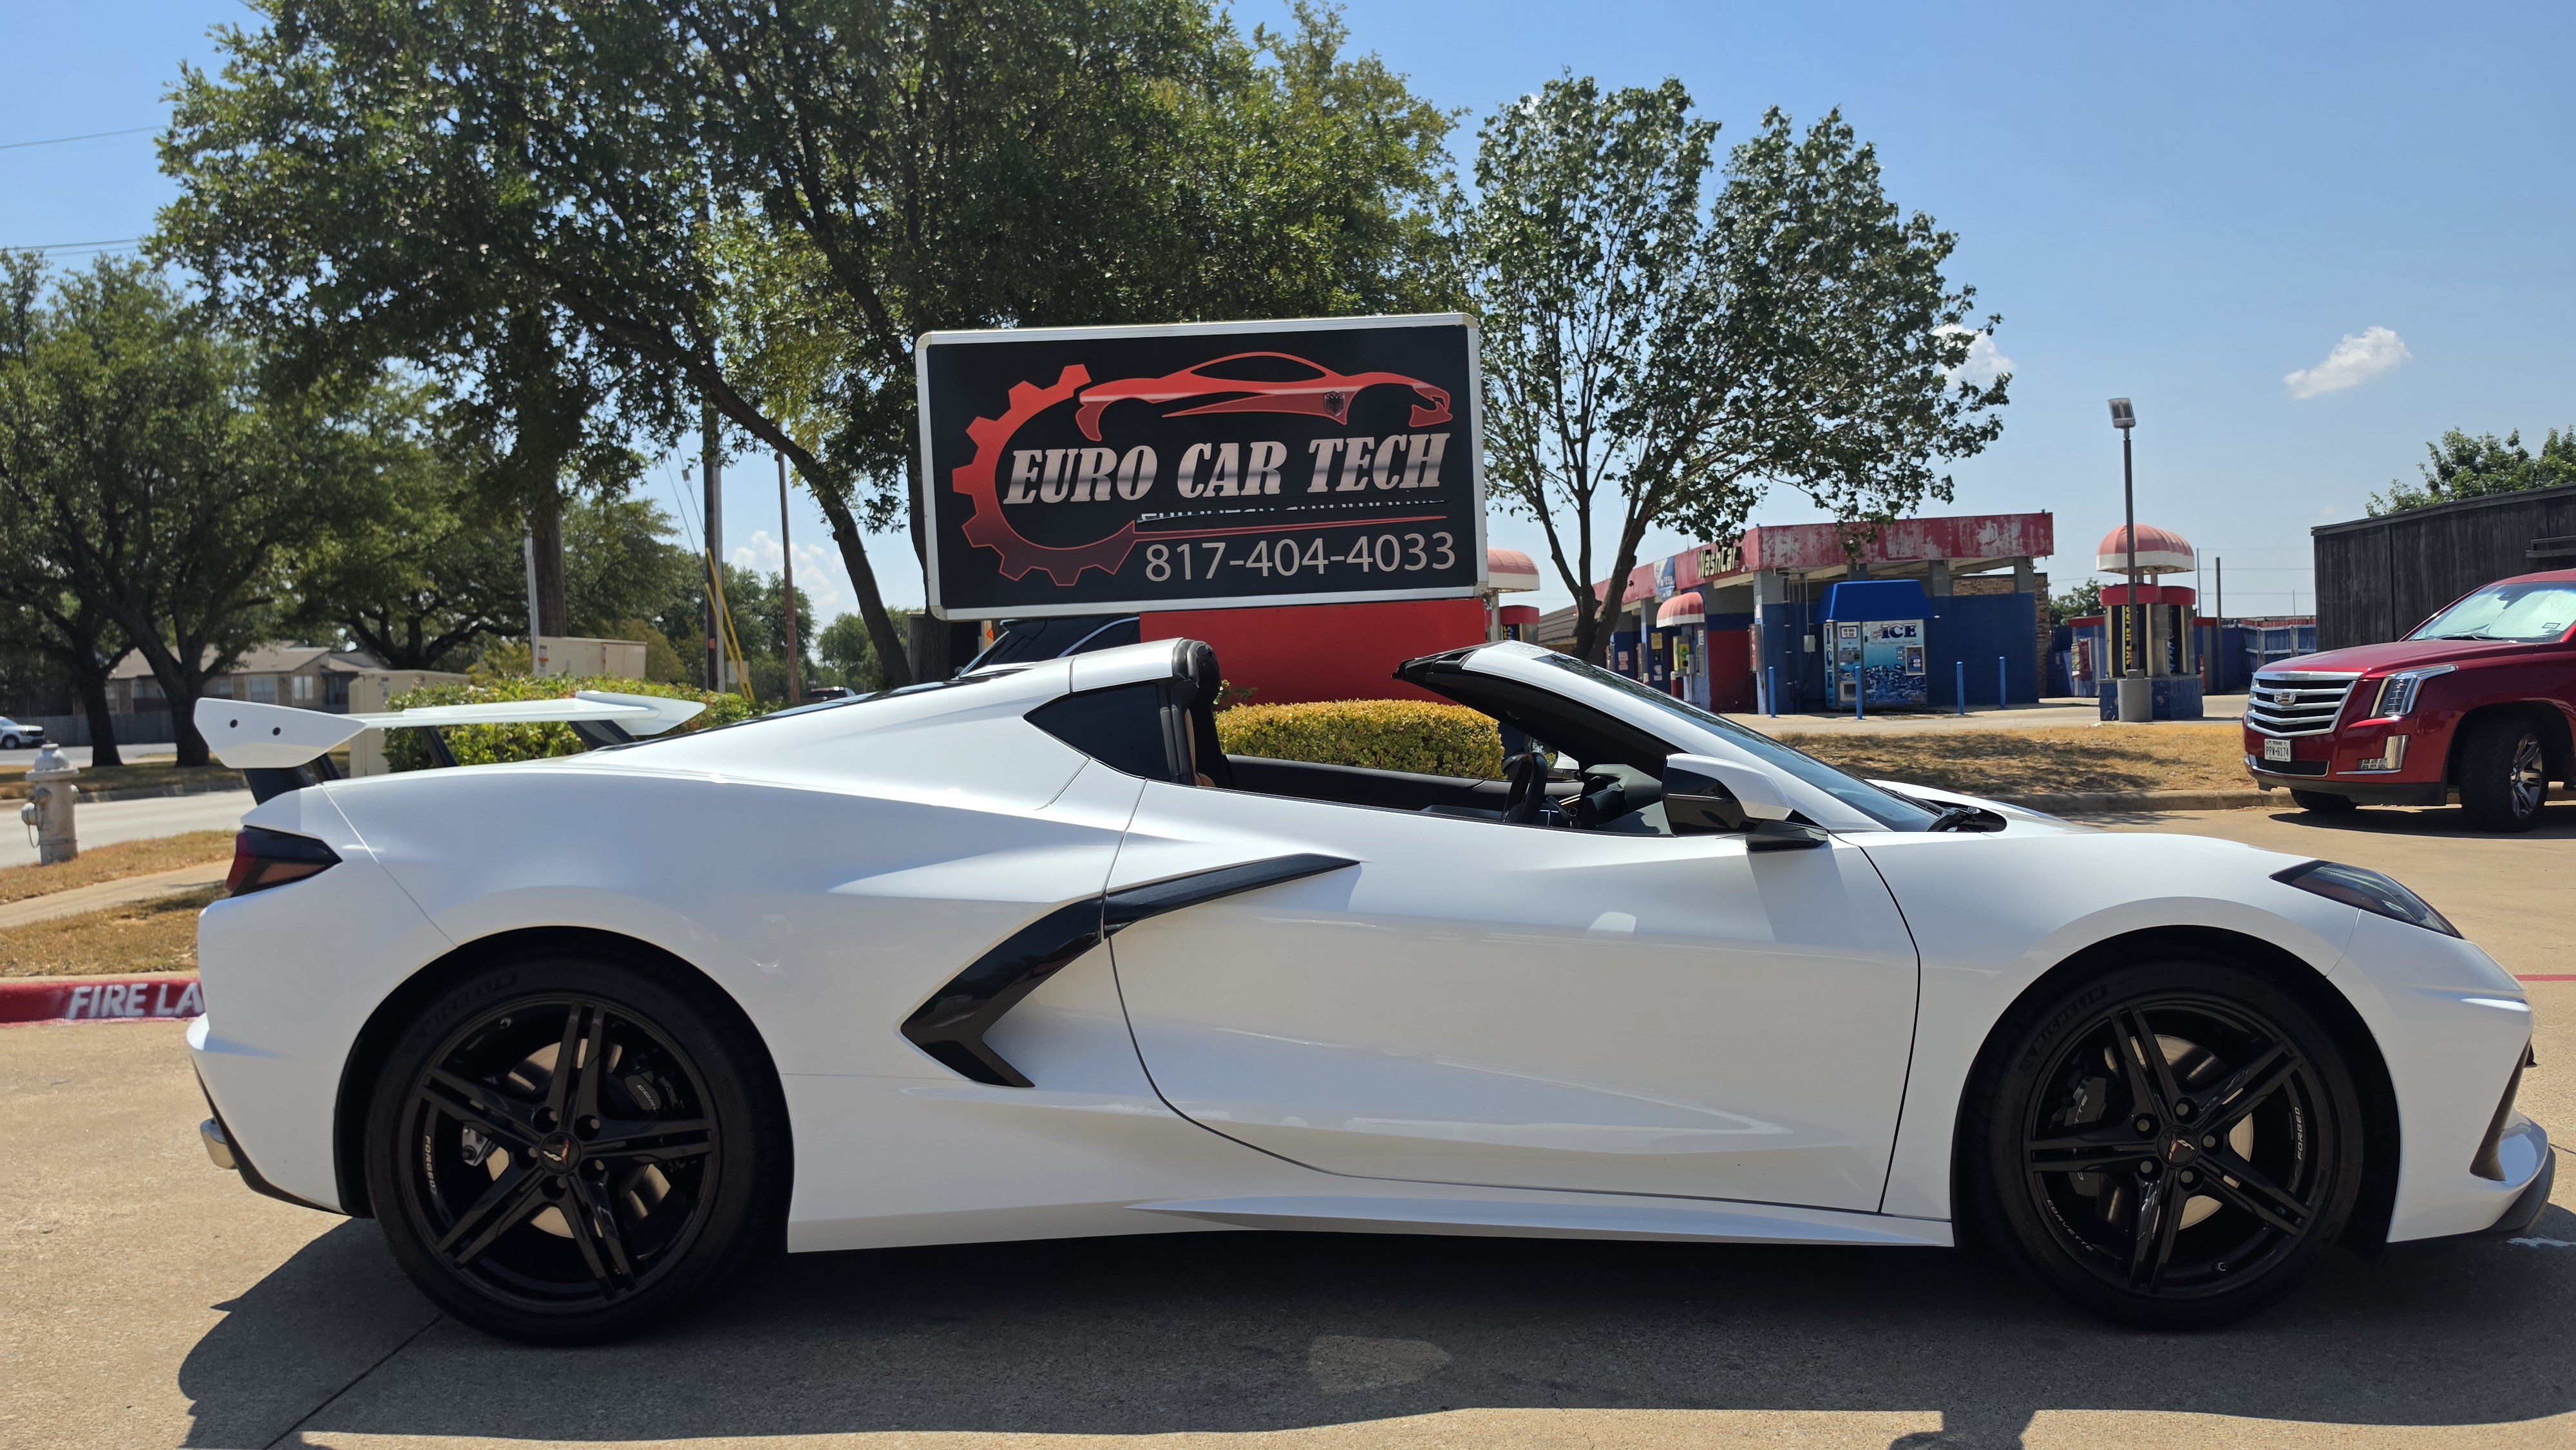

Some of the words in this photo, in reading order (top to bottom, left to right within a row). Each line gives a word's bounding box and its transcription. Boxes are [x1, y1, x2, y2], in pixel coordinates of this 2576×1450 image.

[1003, 445, 1157, 504] EURO
[1177, 440, 1288, 498] CAR
[1308, 433, 1451, 493] TECH
[1146, 531, 1457, 582] 817-404-4033
[1880, 623, 1917, 639] ICE
[68, 983, 149, 1019] FIRE
[155, 982, 204, 1016] LA
[2294, 1106, 2303, 1160] FORGED
[2047, 1199, 2094, 1252] CORVETTE
